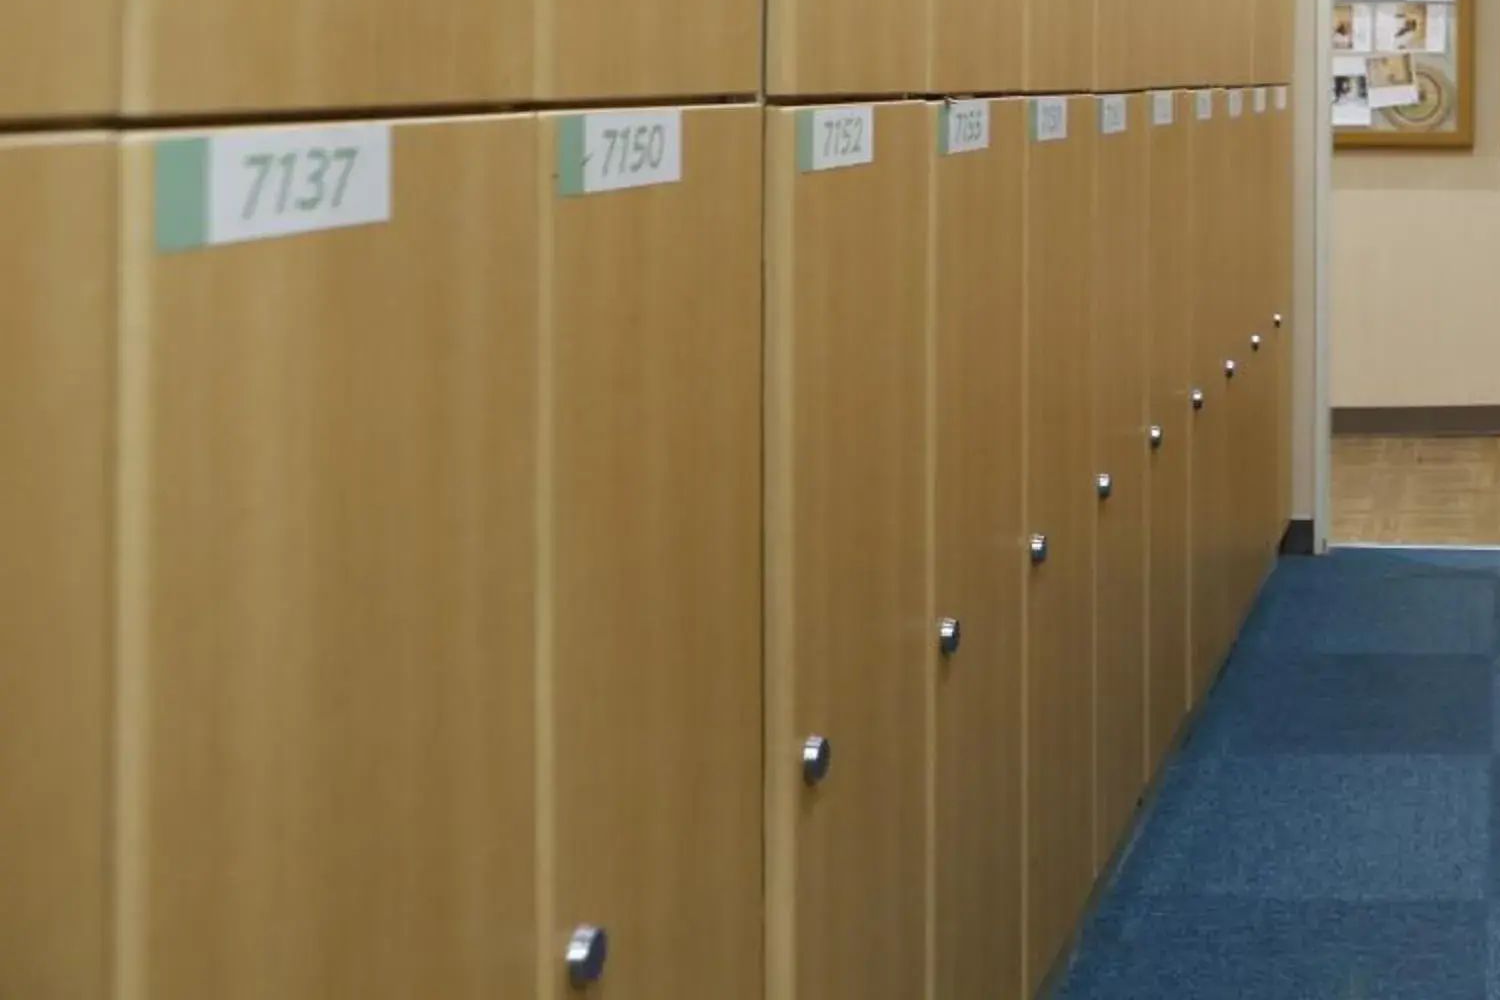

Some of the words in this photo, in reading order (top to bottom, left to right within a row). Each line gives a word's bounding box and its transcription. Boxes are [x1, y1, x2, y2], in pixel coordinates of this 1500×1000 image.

[601, 123, 664, 175] 7150
[822, 117, 863, 157] 7152
[241, 147, 358, 220] 7137
